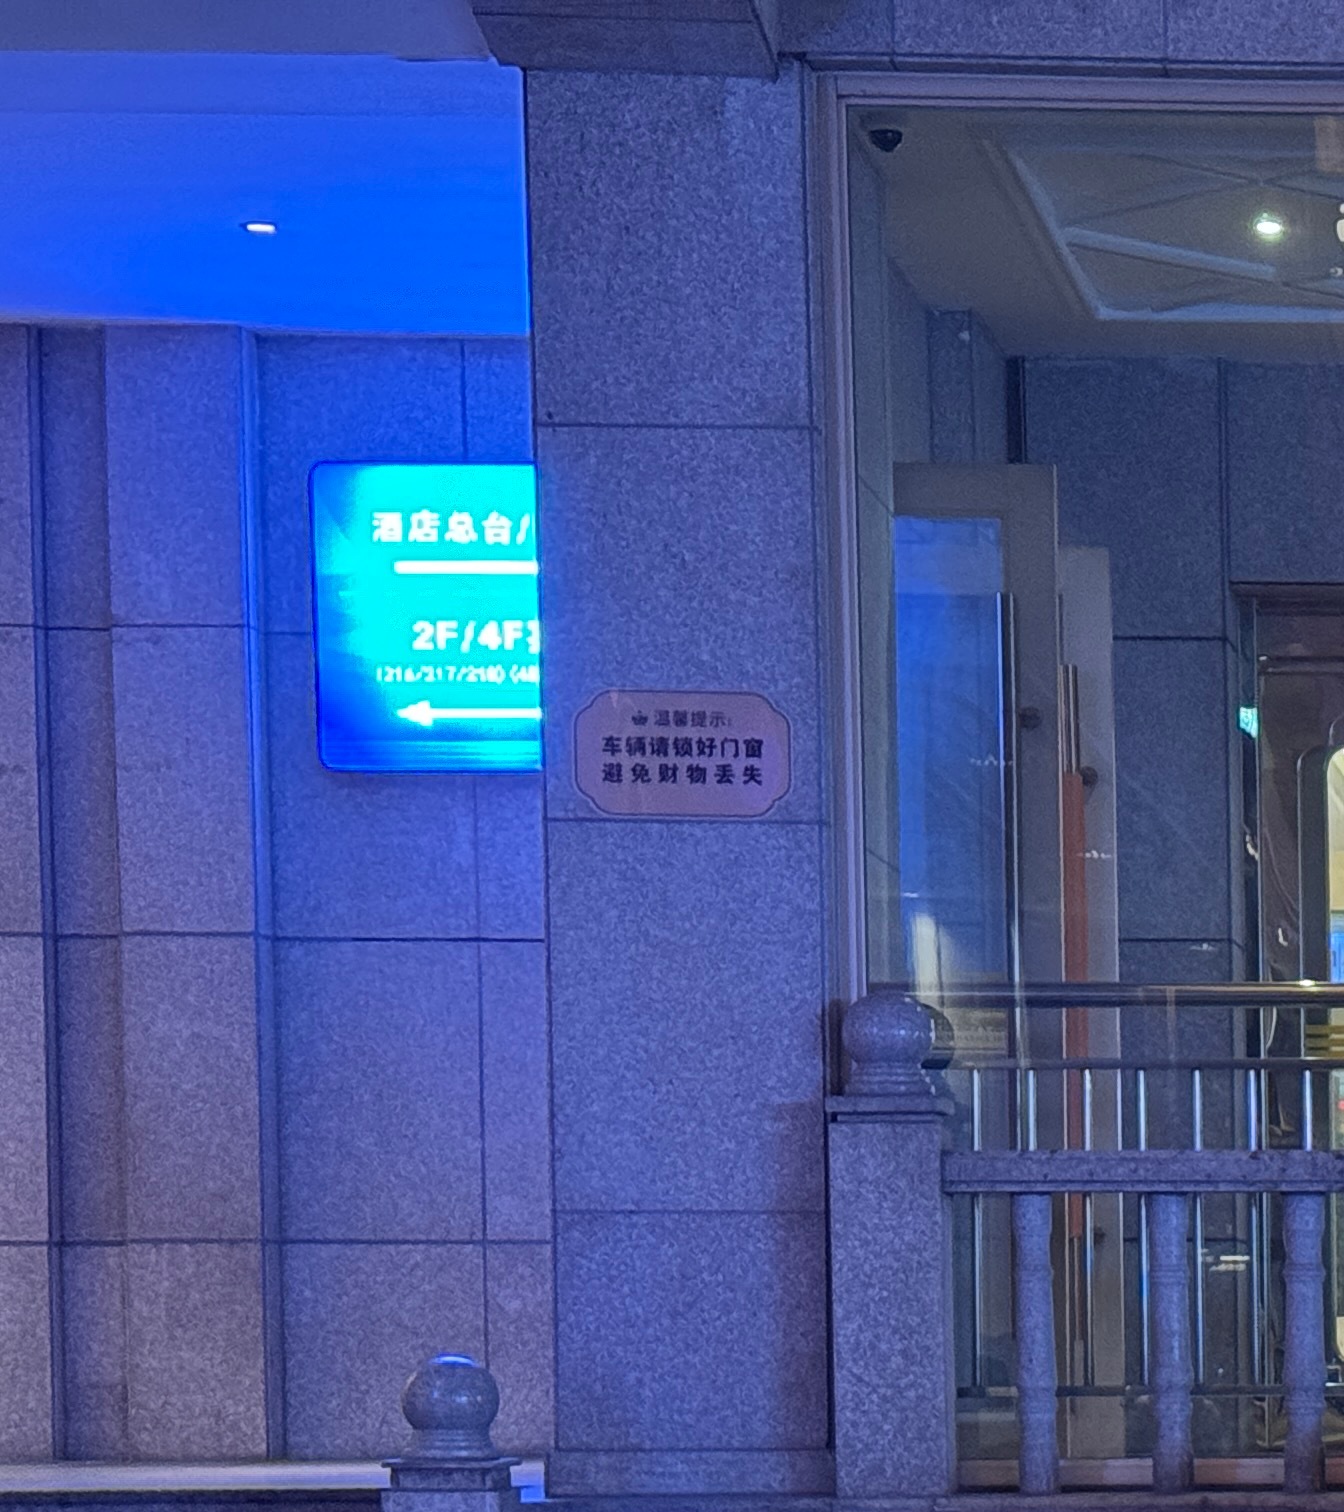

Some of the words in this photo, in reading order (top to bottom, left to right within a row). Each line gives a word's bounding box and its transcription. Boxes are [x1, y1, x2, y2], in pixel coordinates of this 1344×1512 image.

[372, 509, 531, 546] 酒店总台/
[602, 735, 764, 759] 车辆请锁好门窗
[602, 761, 763, 786] 避免财物丢失
